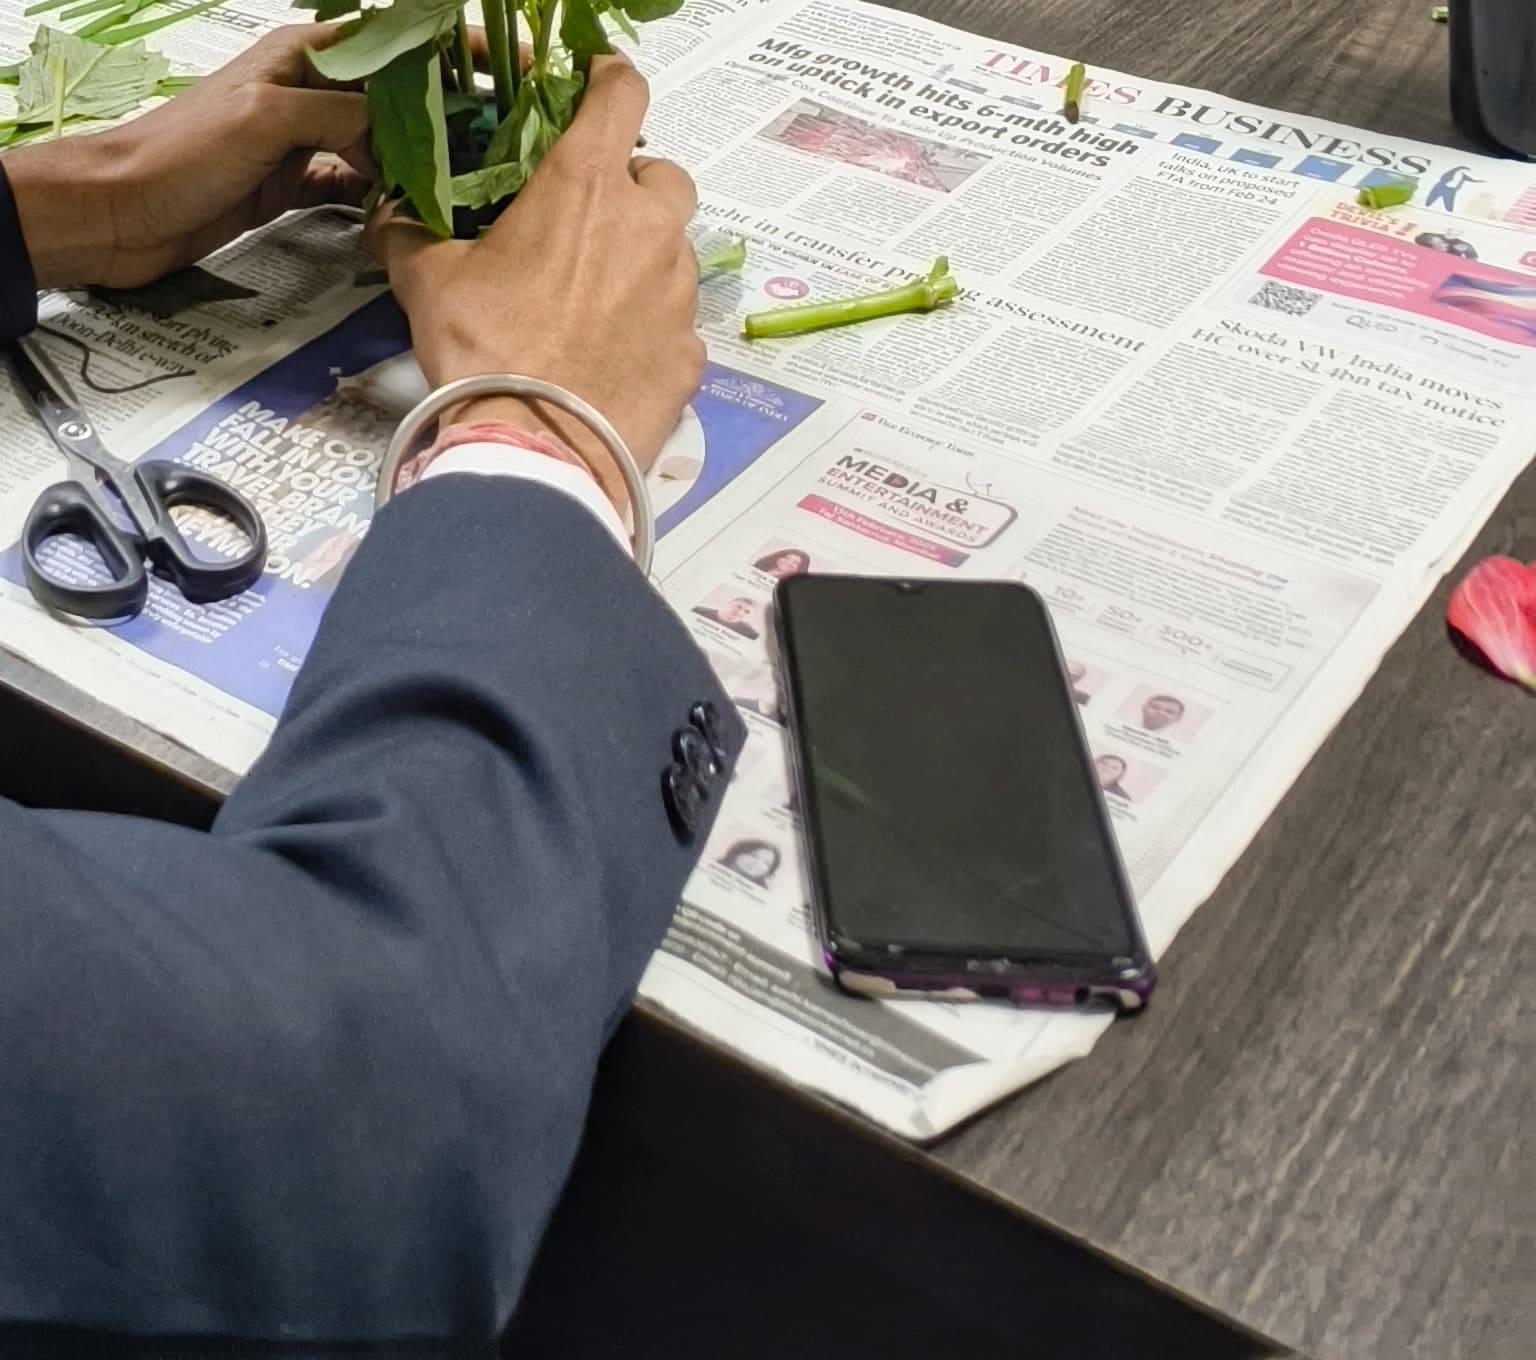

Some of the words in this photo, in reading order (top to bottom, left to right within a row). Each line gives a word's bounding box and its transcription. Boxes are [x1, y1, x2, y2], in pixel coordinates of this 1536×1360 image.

[748, 52, 785, 67] on
[786, 61, 875, 99] uptick
[875, 89, 907, 110] in
[909, 105, 1008, 140] export
[1010, 131, 1112, 169] orders
[757, 38, 811, 59] Mfg
[811, 53, 914, 91] growth
[915, 84, 973, 112] hits
[976, 104, 1066, 137] 6-mth
[1068, 127, 1139, 156] high
[791, 79, 816, 93] Cos
[937, 131, 958, 143] Up
[959, 137, 1038, 165] Production
[1040, 157, 1104, 183] Volumes
[1153, 94, 1433, 176] BUSINESS
[1156, 170, 1184, 184] FTA
[1188, 179, 1226, 194] from
[1226, 187, 1256, 201] Feb
[1255, 194, 1279, 206] 24
[1158, 160, 1195, 177] talks
[1197, 172, 1219, 182] on
[1218, 177, 1297, 199] proposed
[1216, 165, 1239, 176] UK
[1242, 170, 1259, 180] to
[1260, 174, 1301, 189] start
[697, 200, 752, 224] ught
[753, 218, 781, 236] in
[782, 230, 886, 271] transfer
[985, 295, 1146, 353] assessment
[54, 311, 146, 357] Doon-Delhi
[138, 352, 192, 377] e-way
[137, 329, 197, 357] stretch
[1190, 327, 1235, 347] HC
[1236, 342, 1293, 365] over
[1376, 378, 1416, 403] tax
[1422, 397, 1507, 428] notice
[1216, 317, 1289, 348] Skoda
[1349, 352, 1415, 383] India
[1418, 375, 1506, 411] moves
[217, 412, 283, 456] FALL
[280, 446, 321, 470] IN
[315, 459, 377, 494] LOV
[238, 400, 327, 449] MAKE
[182, 440, 281, 499] TRAVEL
[278, 489, 372, 539] BRAN
[204, 426, 278, 475] WITH
[278, 465, 358, 507] YOUR
[826, 467, 989, 535] ENTERTAINMENT
[835, 454, 938, 505] MEDIA
[945, 497, 969, 516] &
[817, 476, 875, 503] SUMMIT
[877, 501, 910, 519] AND
[912, 516, 978, 544] AWARDS
